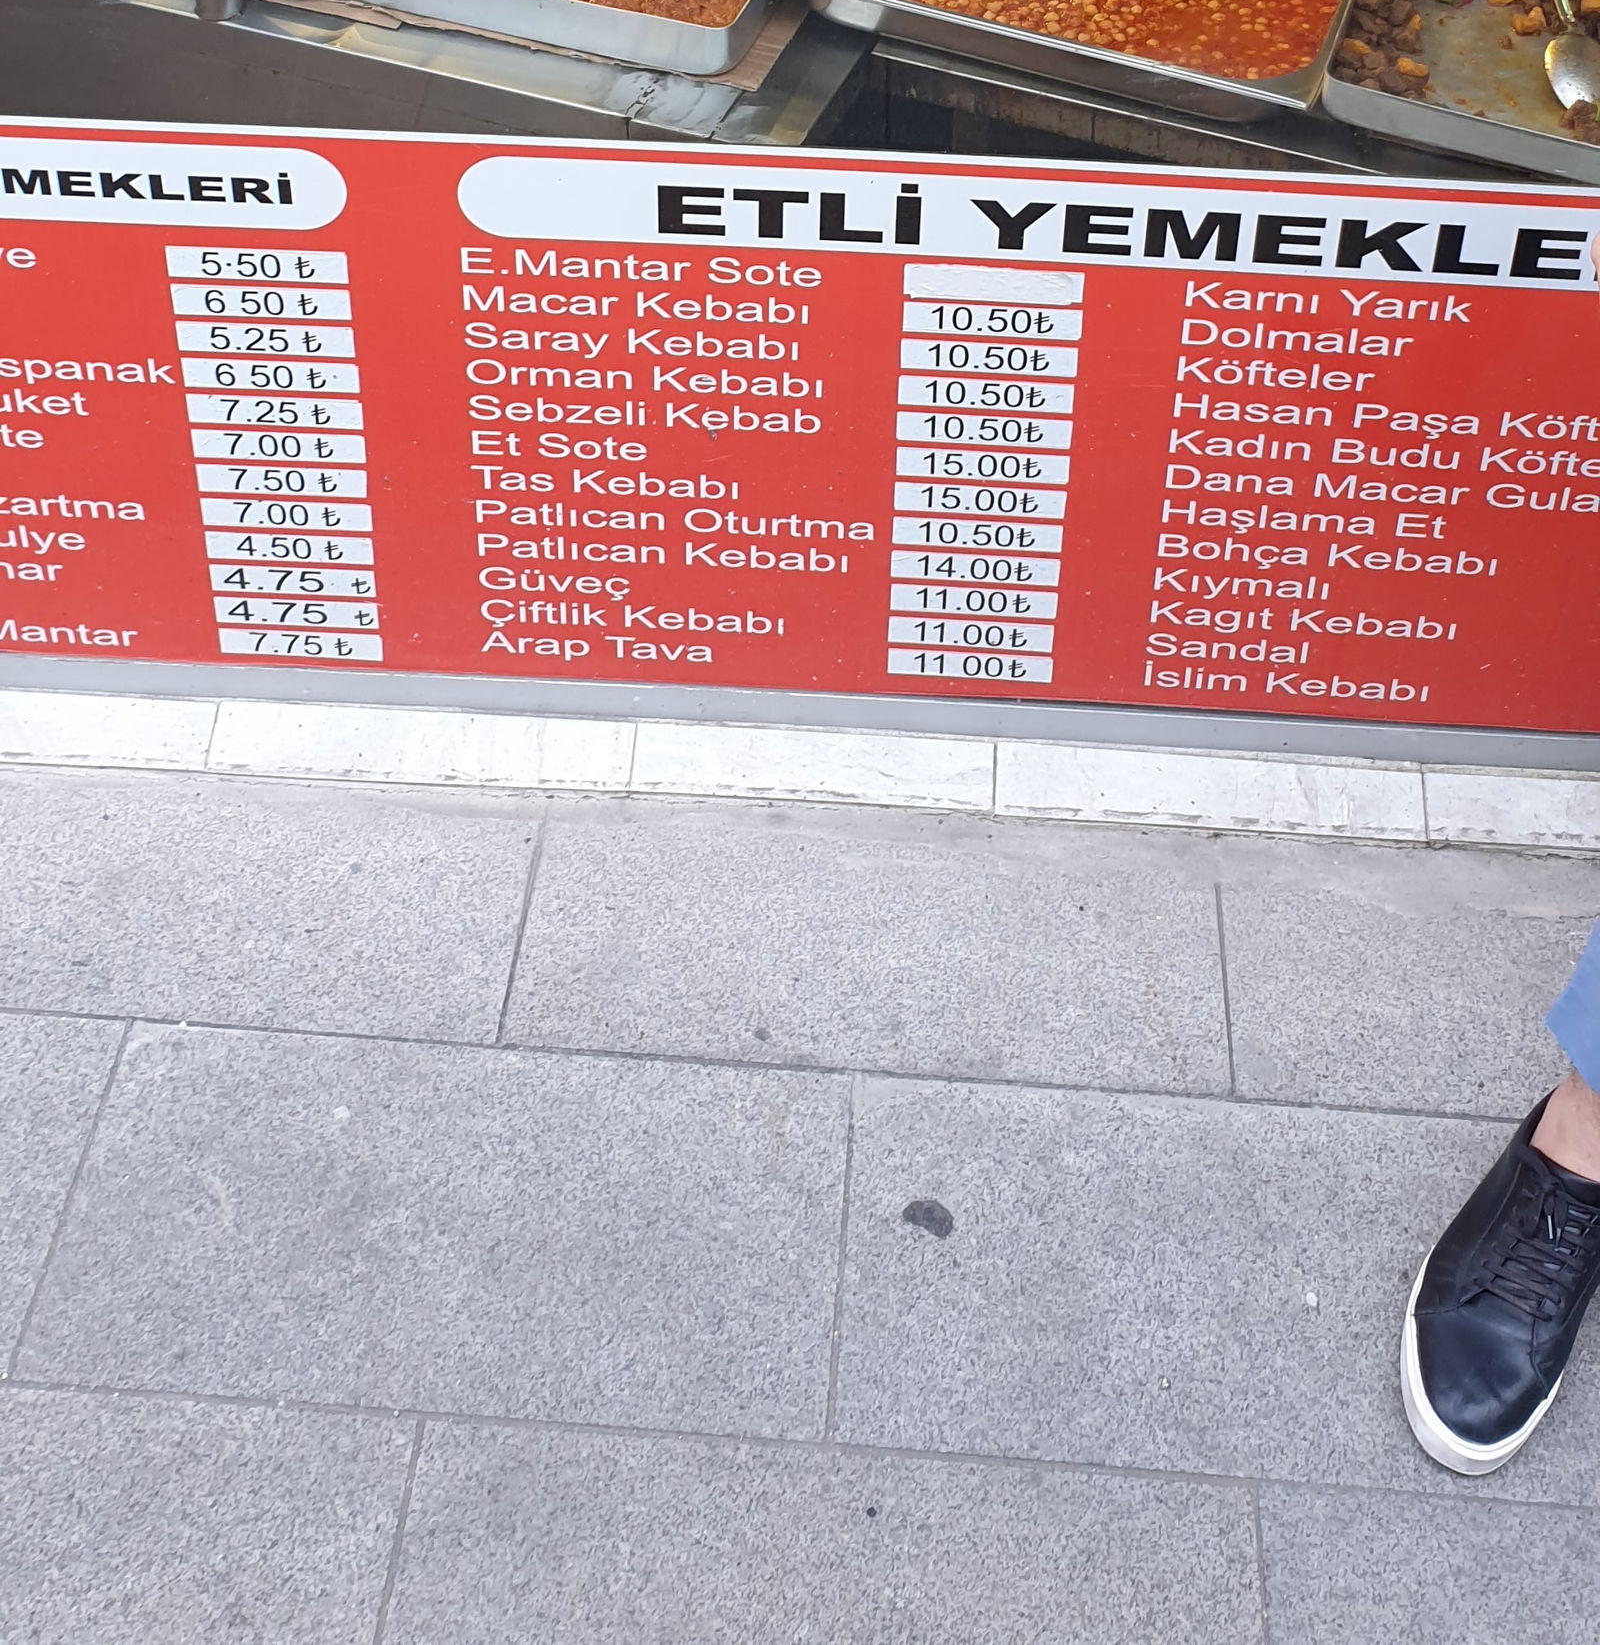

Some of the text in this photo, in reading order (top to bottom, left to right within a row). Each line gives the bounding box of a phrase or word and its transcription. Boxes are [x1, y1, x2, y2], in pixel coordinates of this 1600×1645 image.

[656, 183, 1599, 281] ETLİ YEMEKLE
[460, 246, 822, 288] E.Mantar Sote
[462, 284, 809, 325] Macar Kebabı
[1185, 280, 1471, 323] Karnı Yarık
[209, 326, 290, 354] 5.25
[464, 321, 799, 361] Saray Kebabı
[1181, 318, 1414, 357] Dolmalar
[466, 358, 823, 399] Orman Kebabı
[1176, 355, 1376, 392] Köfteler
[220, 398, 299, 427] 7.25
[468, 394, 822, 434] Sebzeli Kebab
[1173, 392, 1333, 427] Hasan
[1353, 403, 1480, 440] Paşa
[223, 433, 301, 458] 7.00
[471, 430, 647, 462] Et Sote
[1168, 428, 1311, 462] Kadın
[1331, 438, 1460, 470] Budu
[228, 468, 305, 493] 7.50
[470, 464, 739, 500] Tas Kebabı
[1165, 464, 1600, 513] Dana Macar Gula
[233, 501, 309, 526] 7.00
[475, 499, 874, 541] Patlıcan Oturtma
[1161, 499, 1447, 539] Haşlama Et
[236, 535, 312, 560] 4.50
[477, 533, 848, 573] Patlıcan Kebabı
[1157, 533, 1498, 576] Bohça Kebabı
[223, 568, 324, 593] 4.75
[478, 566, 631, 602] Güveç
[1153, 567, 1330, 600] Kıymalı
[228, 600, 328, 625] 4.75
[480, 598, 784, 635] Çiftlik Kebabı
[1290, 608, 1457, 640] Kebabı
[249, 632, 323, 656] 7.75
[480, 630, 713, 663] Arap Tava
[1145, 633, 1309, 664] Sandal
[1143, 660, 1429, 702] İslim Kebabı
